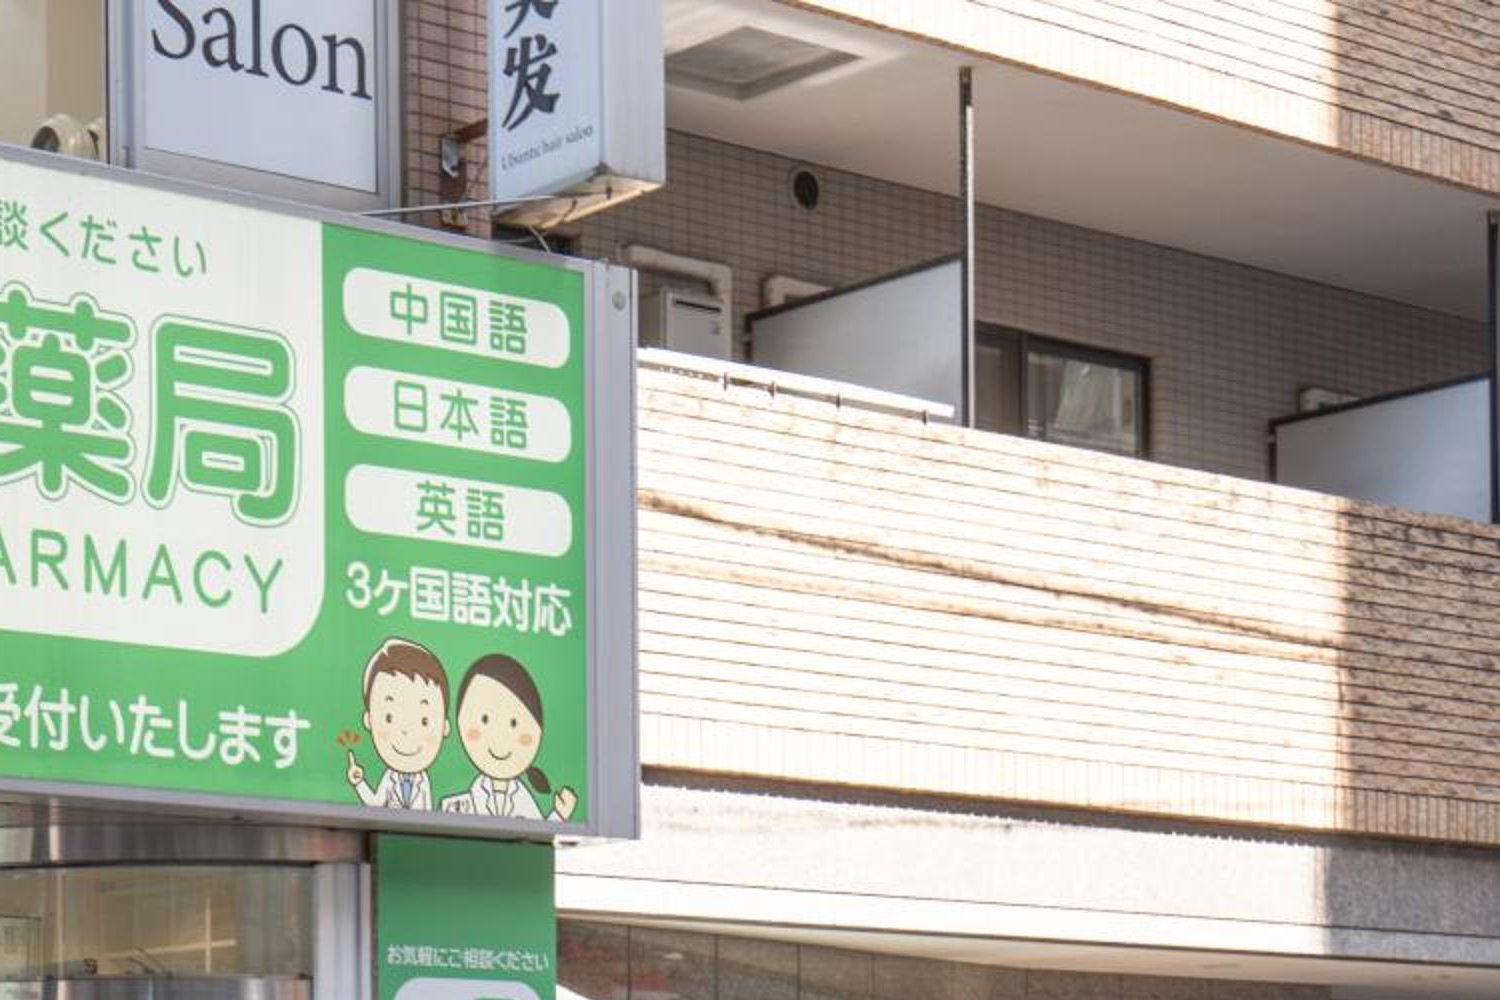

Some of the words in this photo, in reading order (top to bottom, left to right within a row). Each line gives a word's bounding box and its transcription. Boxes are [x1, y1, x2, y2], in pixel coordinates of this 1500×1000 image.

[151, 0, 373, 101] Salon
[390, 282, 528, 355] 中国語
[392, 379, 529, 450] 日本語
[415, 478, 506, 542] 英語
[387, 944, 549, 972] お気軽にご相談ください
